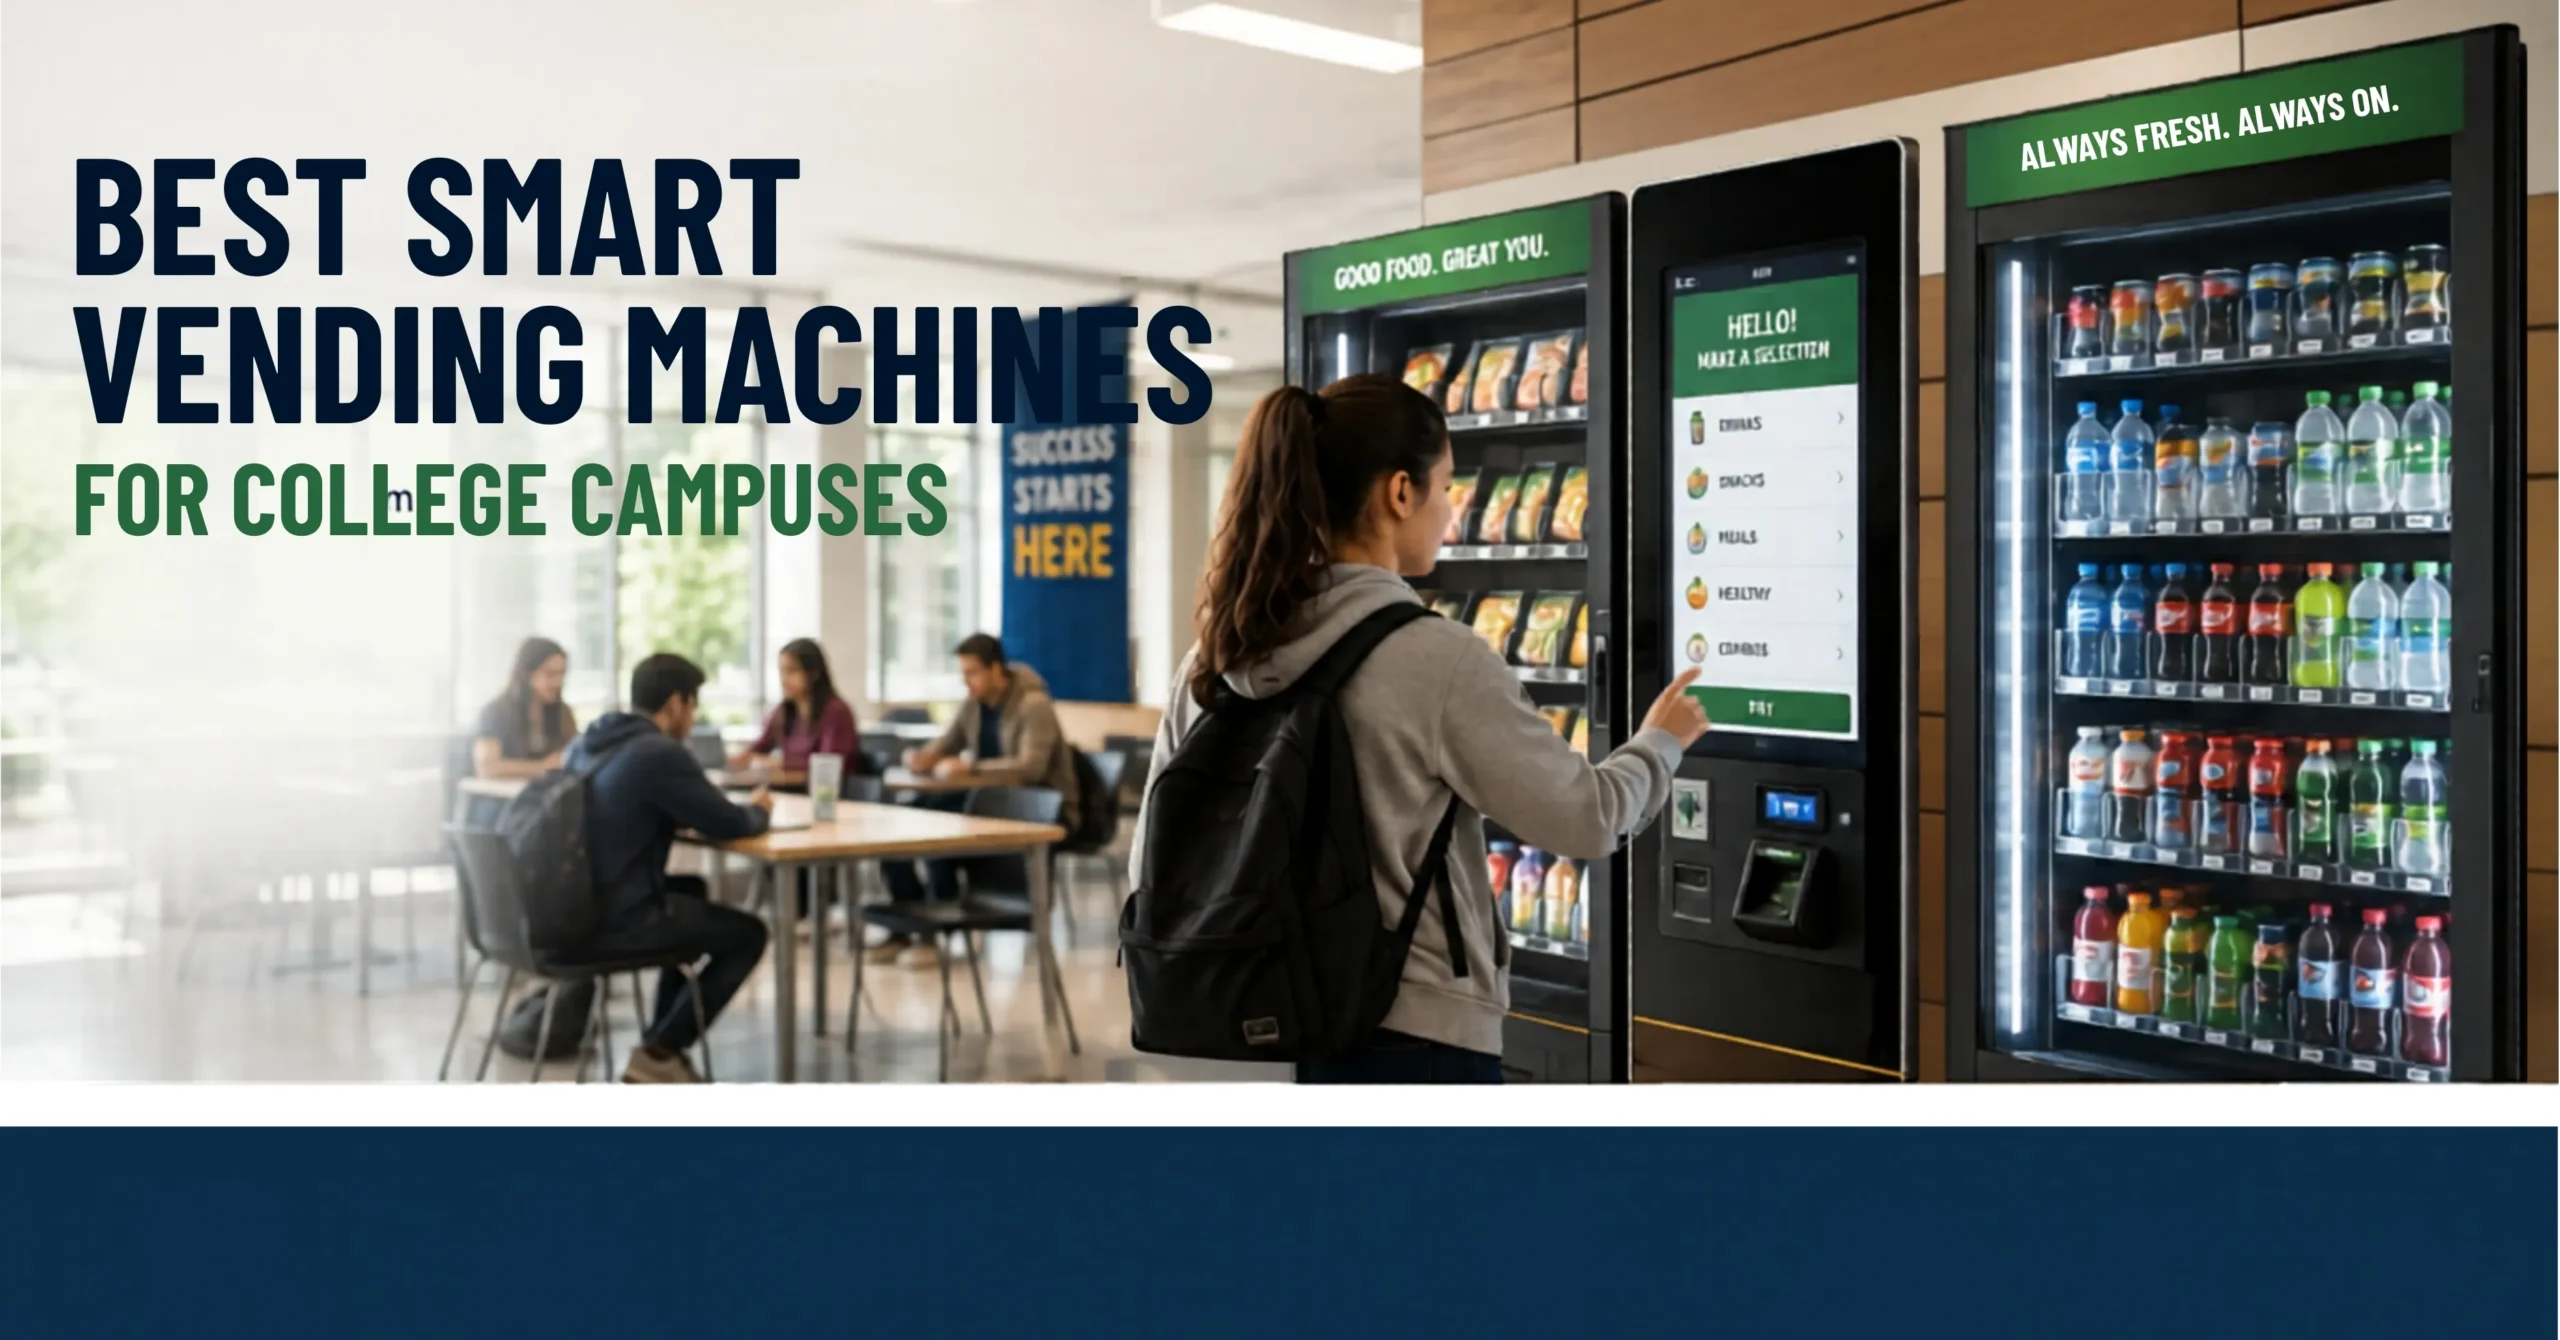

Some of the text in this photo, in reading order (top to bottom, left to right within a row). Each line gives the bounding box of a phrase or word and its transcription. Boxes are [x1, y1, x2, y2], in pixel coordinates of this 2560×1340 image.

[2021, 84, 2400, 172] ALWAYS FRESH. ALWAYS ON.
[1385, 253, 1438, 283] FOOD.
[1442, 241, 1500, 272] GREAT
[1504, 233, 1549, 263] YOU.
[1728, 307, 1797, 339] HELLO!
[1011, 424, 1117, 467] SUCCESS
[1013, 473, 1113, 514] STARTS
[1013, 522, 1114, 579] HERE
